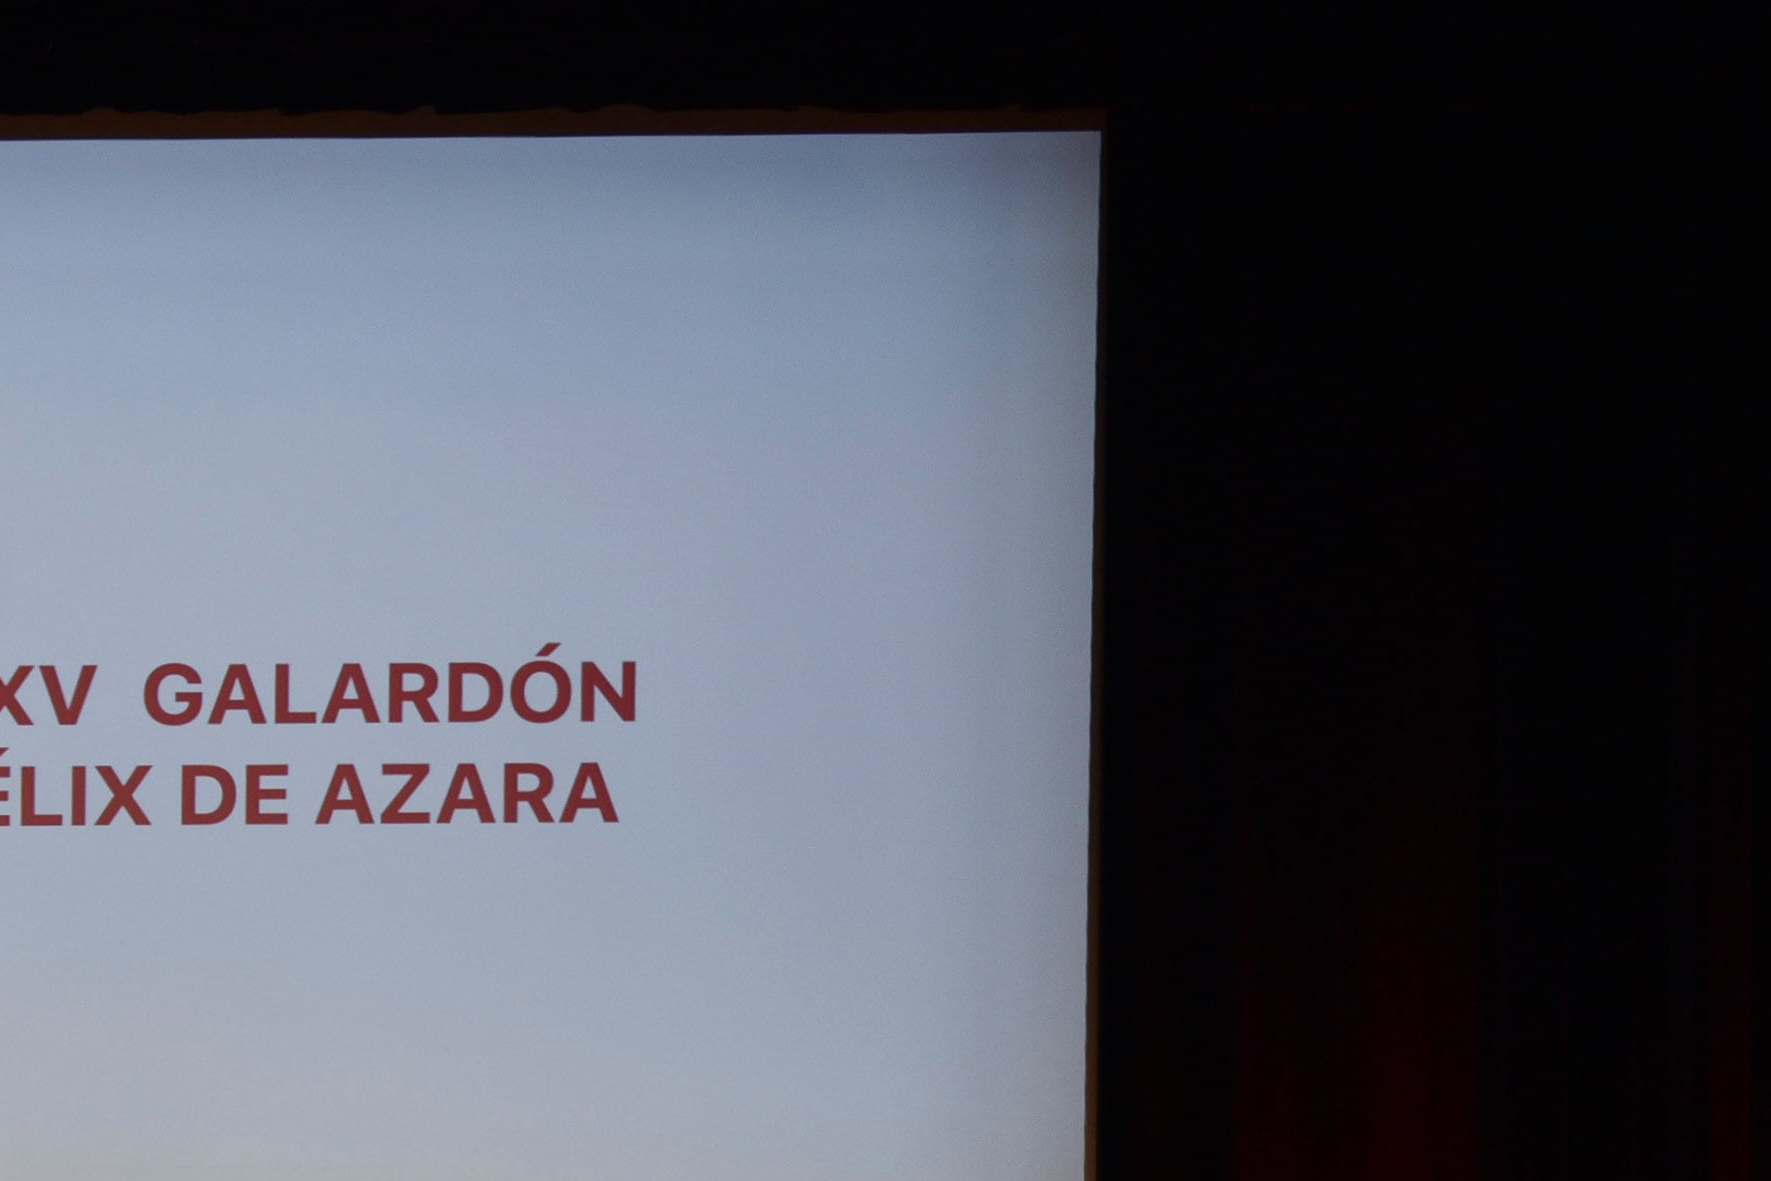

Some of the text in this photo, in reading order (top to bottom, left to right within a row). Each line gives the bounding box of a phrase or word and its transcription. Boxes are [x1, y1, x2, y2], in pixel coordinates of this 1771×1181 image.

[143, 642, 638, 726] GALARDÓN
[179, 764, 290, 827] DE
[315, 762, 620, 826] AZARA
